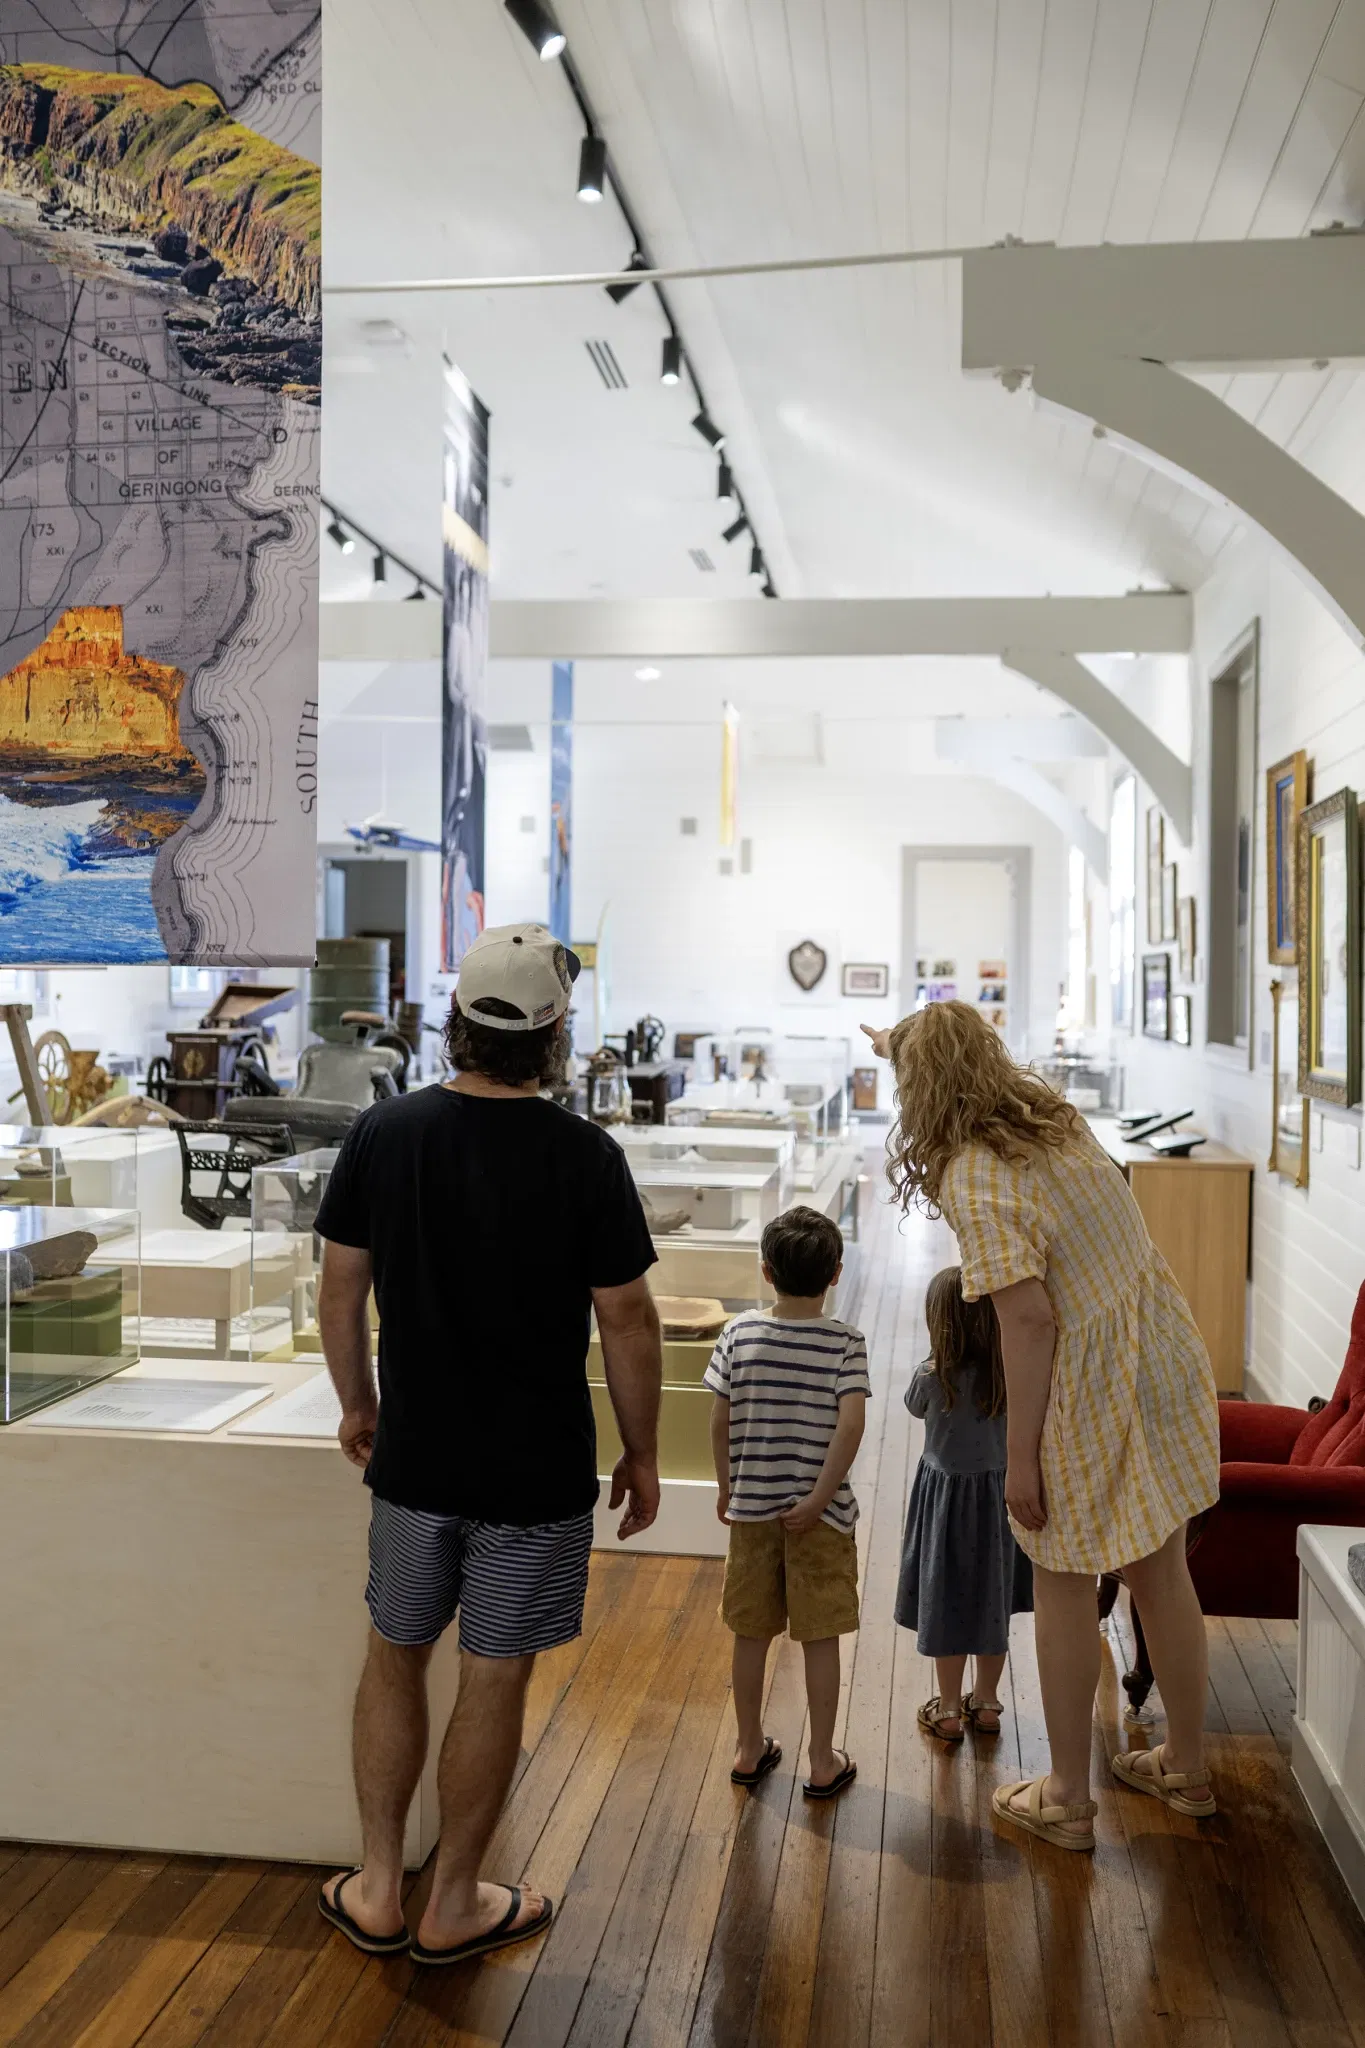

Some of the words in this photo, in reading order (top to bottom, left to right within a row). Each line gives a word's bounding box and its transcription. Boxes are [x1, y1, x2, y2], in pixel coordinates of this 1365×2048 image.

[92, 335, 151, 376] SECTION
[180, 381, 211, 407] LINE
[135, 415, 202, 432] VILLAGE
[273, 427, 288, 444] D
[157, 449, 179, 464] OF
[118, 479, 223, 498] GERINGONG
[31, 523, 55, 539] 173
[46, 546, 65, 556] XXI
[145, 604, 164, 614] XXI
[295, 697, 319, 814] SOUTH
